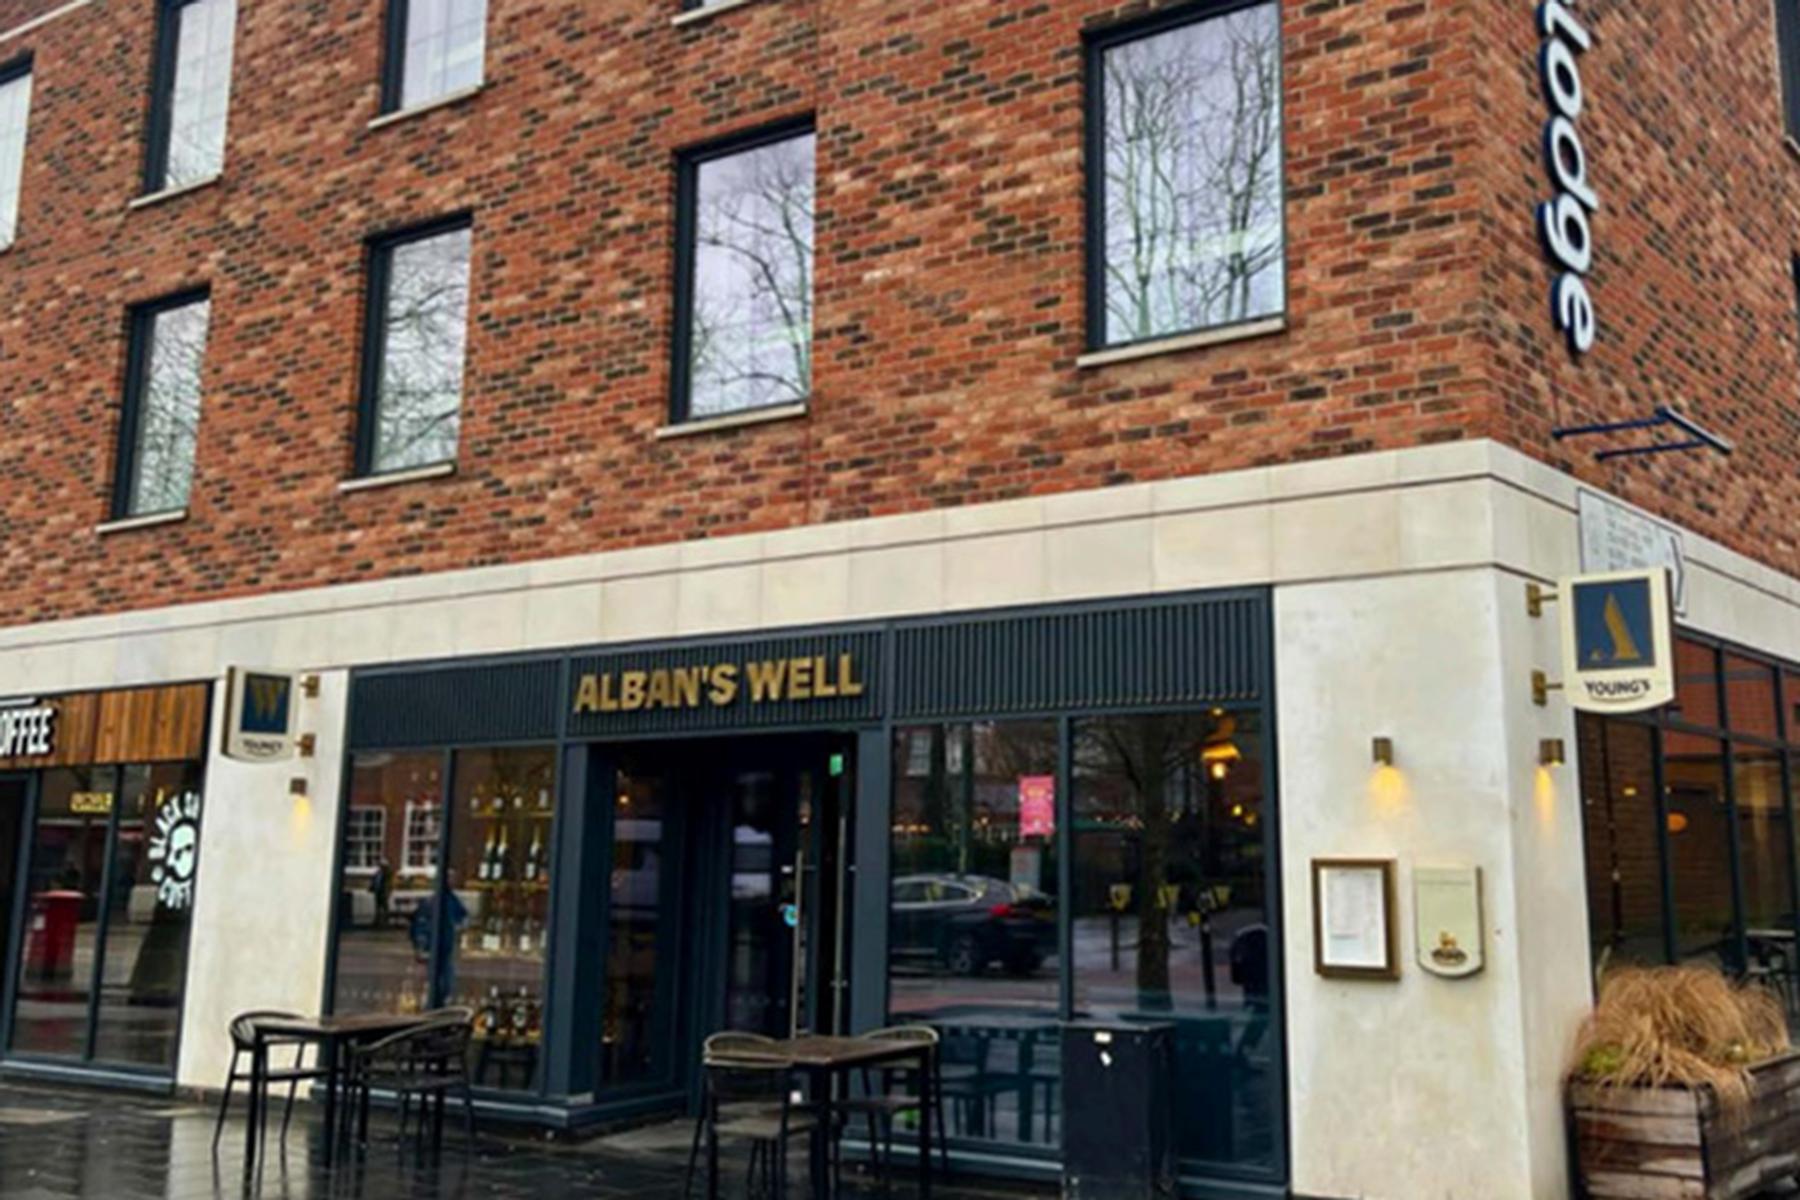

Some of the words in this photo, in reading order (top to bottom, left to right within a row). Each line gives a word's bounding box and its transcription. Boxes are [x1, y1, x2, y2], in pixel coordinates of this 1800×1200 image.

[573, 664, 738, 713] ALBAN'S
[746, 653, 864, 702] WELL
[1584, 679, 1651, 697] YOUNG'S
